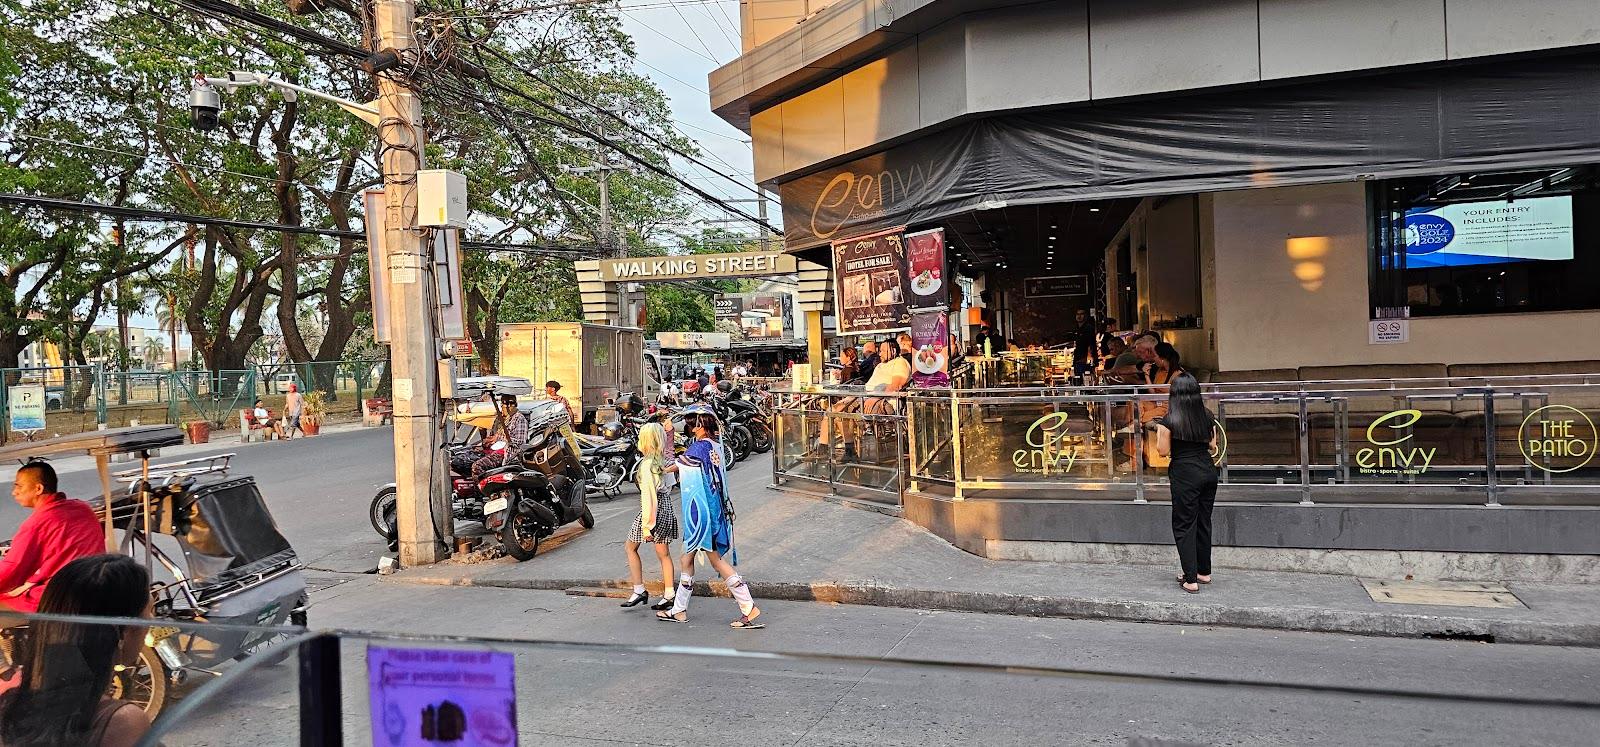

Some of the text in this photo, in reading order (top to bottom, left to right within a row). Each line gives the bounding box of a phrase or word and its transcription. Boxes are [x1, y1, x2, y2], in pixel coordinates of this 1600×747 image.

[1495, 206, 1530, 214] ENTRY
[1463, 216, 1521, 224] INCLUDES:
[1420, 237, 1448, 245] 2024
[612, 254, 779, 278] WALKING STREET
[847, 255, 891, 271] HOTEL FOR SALE
[1529, 419, 1588, 457] THE PATIO
[1012, 449, 1078, 473] envy
[1356, 447, 1437, 473] envy
[412, 671, 462, 686] personal
